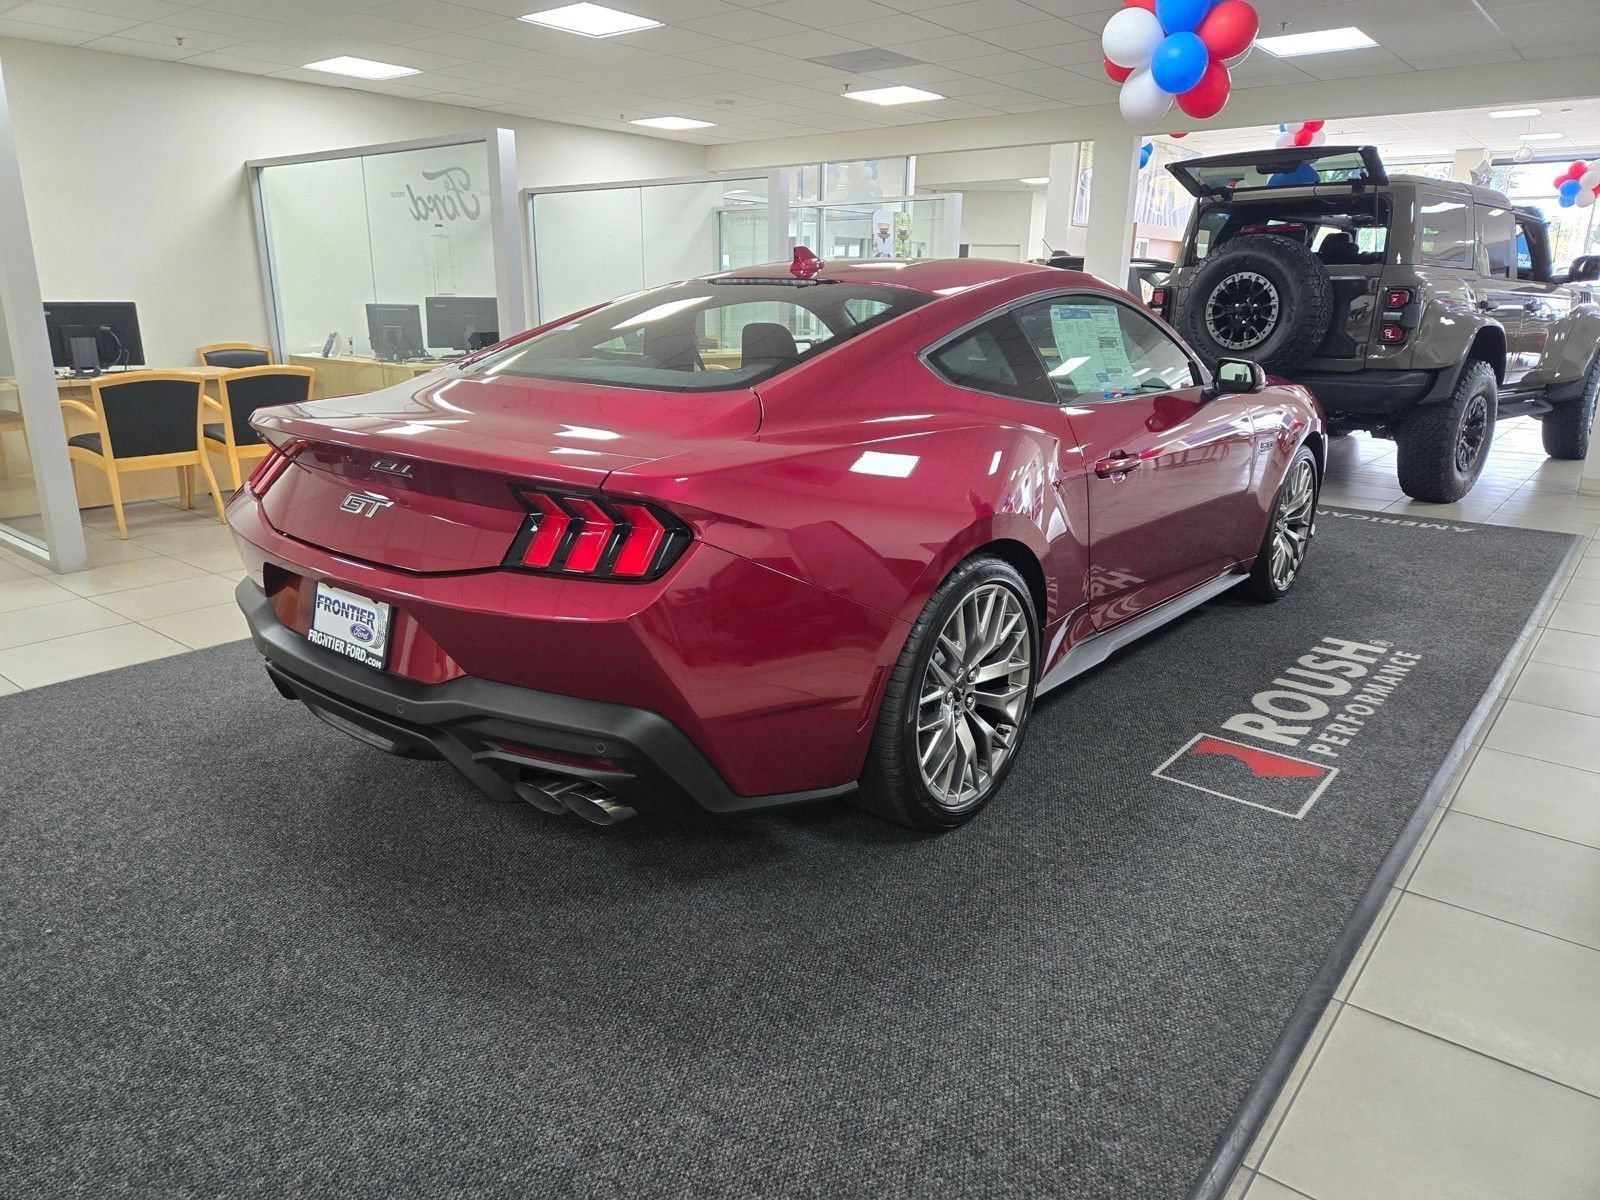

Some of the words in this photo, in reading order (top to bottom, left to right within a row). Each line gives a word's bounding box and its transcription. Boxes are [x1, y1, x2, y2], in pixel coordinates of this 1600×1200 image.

[340, 490, 395, 518] GT
[316, 594, 376, 629] FRONTIER
[308, 629, 345, 655] FRONTIER
[352, 625, 371, 641] Ford
[1220, 636, 1388, 747] ROUSH
[1307, 650, 1422, 757] PERFORMANCE
